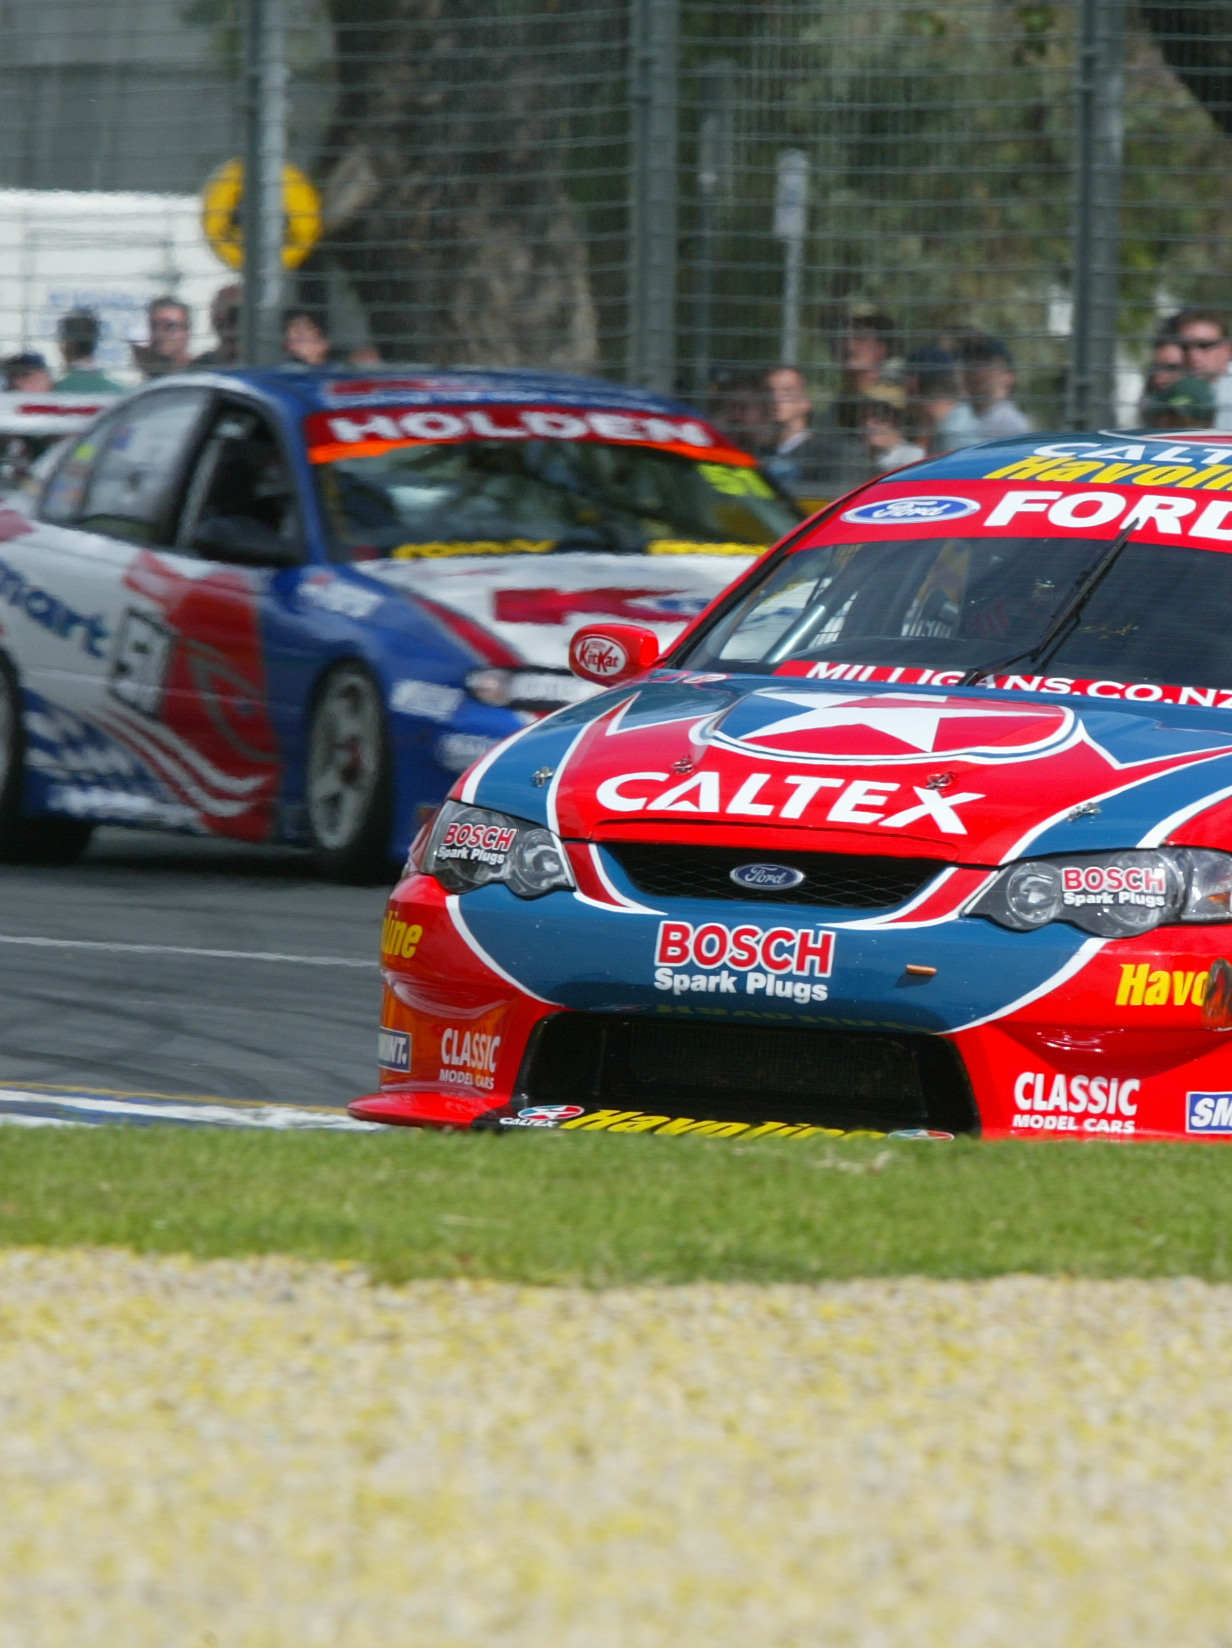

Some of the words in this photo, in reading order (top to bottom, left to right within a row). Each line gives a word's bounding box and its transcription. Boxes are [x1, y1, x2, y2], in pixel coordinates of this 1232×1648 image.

[328, 411, 713, 448] HOLDEN
[882, 499, 946, 520] Ford
[578, 640, 620, 673] KitKat
[596, 771, 987, 835] CALTEX
[441, 822, 518, 852] BOSCH
[438, 845, 469, 862] Spark
[470, 848, 506, 866] Plugs
[743, 866, 789, 887] Ford
[1061, 866, 1167, 894] BOSCH
[1063, 892, 1114, 907] Spark
[1118, 892, 1165, 907] Plugs
[382, 910, 423, 958] line
[654, 920, 837, 977] BOSCH
[653, 967, 737, 996] Spark
[745, 973, 828, 1004] Plugs
[440, 1027, 501, 1074] CLASSIC
[439, 1068, 473, 1086] MODEL
[474, 1076, 495, 1091] CARS
[1012, 1071, 1141, 1117] CLASSIC
[499, 1117, 559, 1128] CALTEX
[1012, 1114, 1078, 1131] MODEL
[1083, 1117, 1135, 1134] CARS
